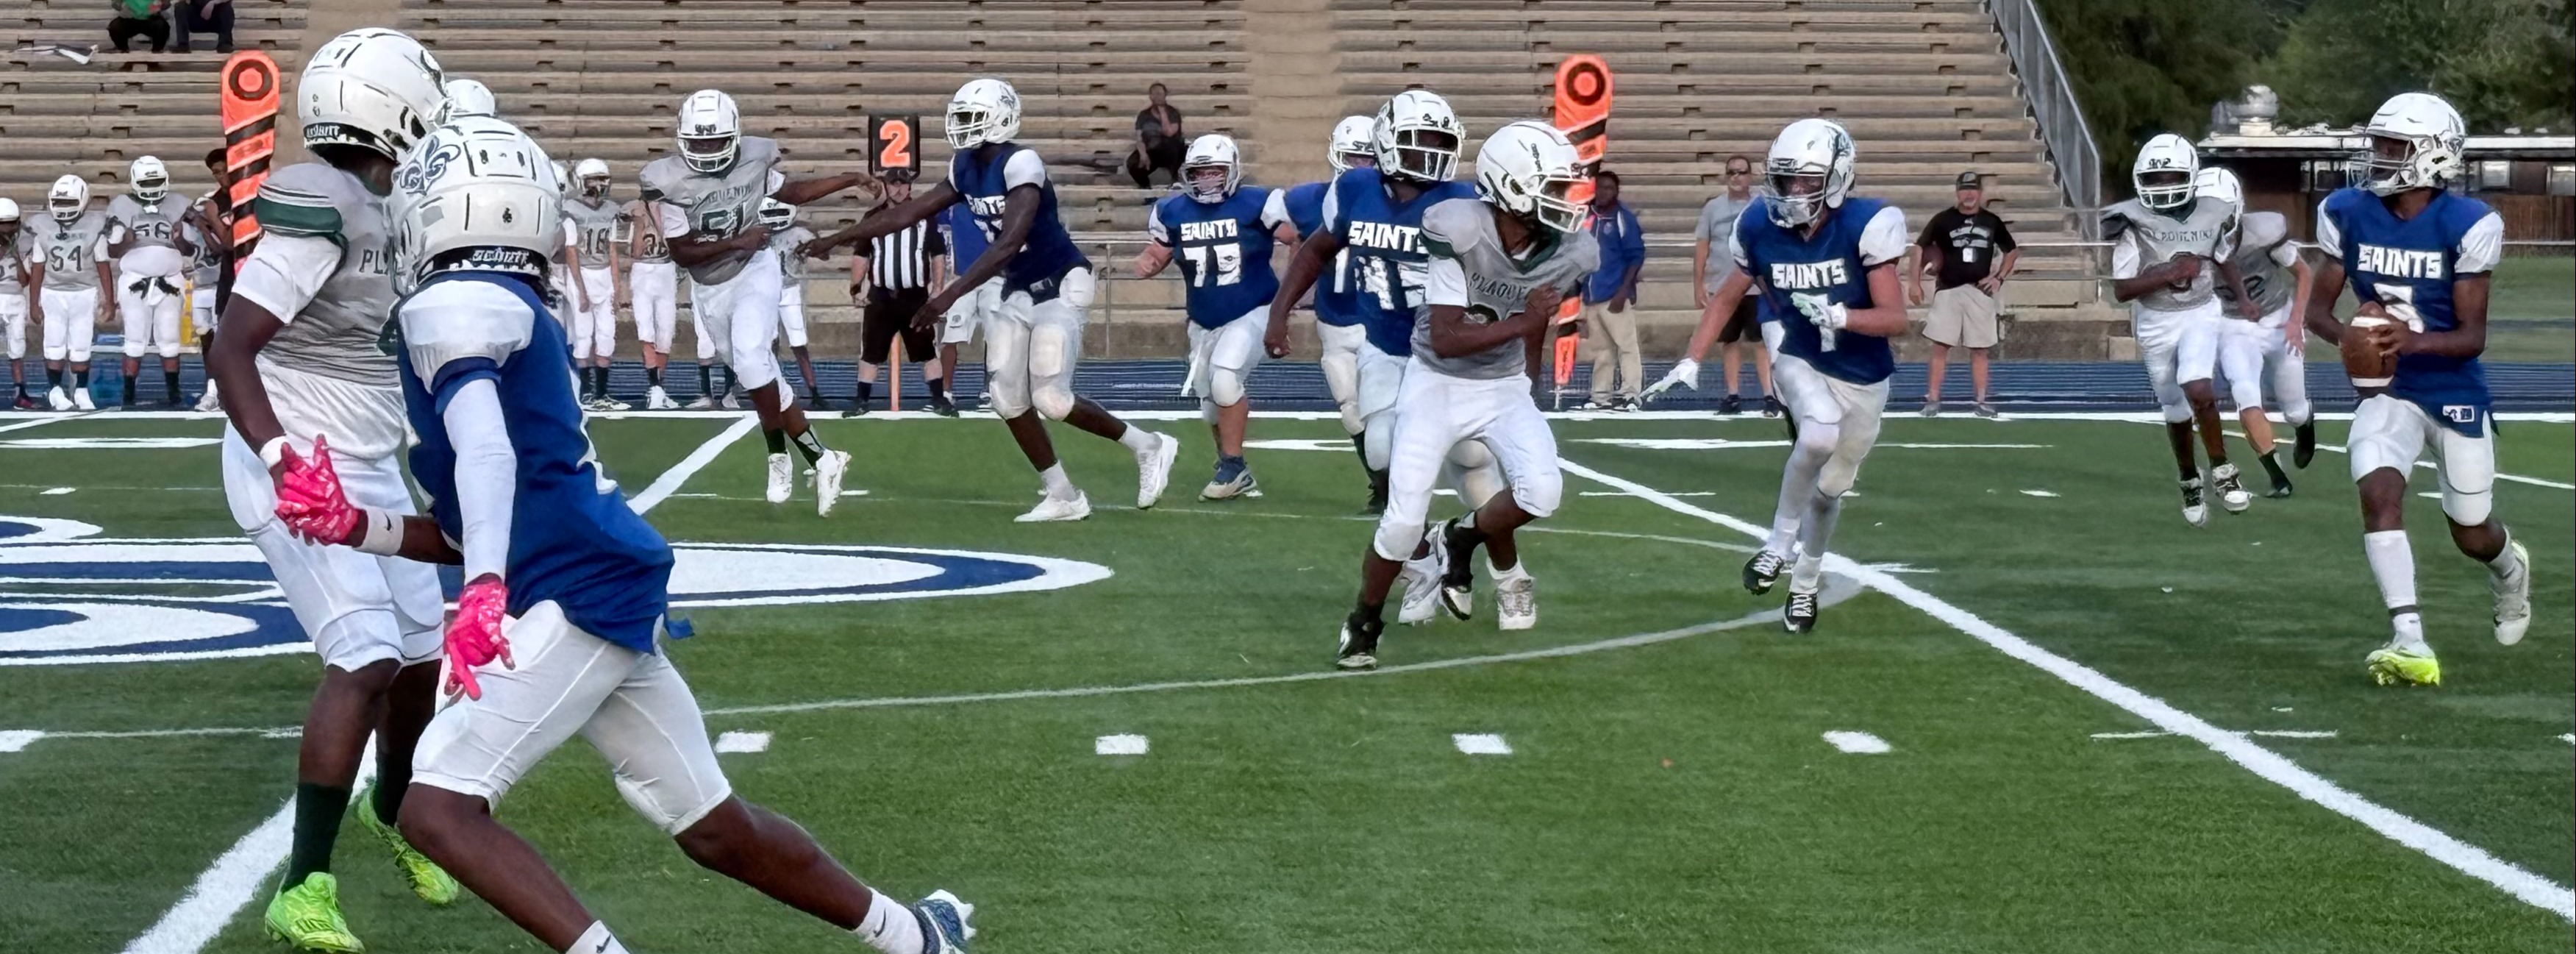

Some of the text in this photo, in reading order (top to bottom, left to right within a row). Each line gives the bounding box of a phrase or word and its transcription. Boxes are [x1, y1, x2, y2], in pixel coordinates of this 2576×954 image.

[880, 120, 910, 168] 2
[1180, 218, 1238, 241] SAINTS
[1771, 258, 1848, 290] SAINTS
[2357, 243, 2442, 280] SAINTS
